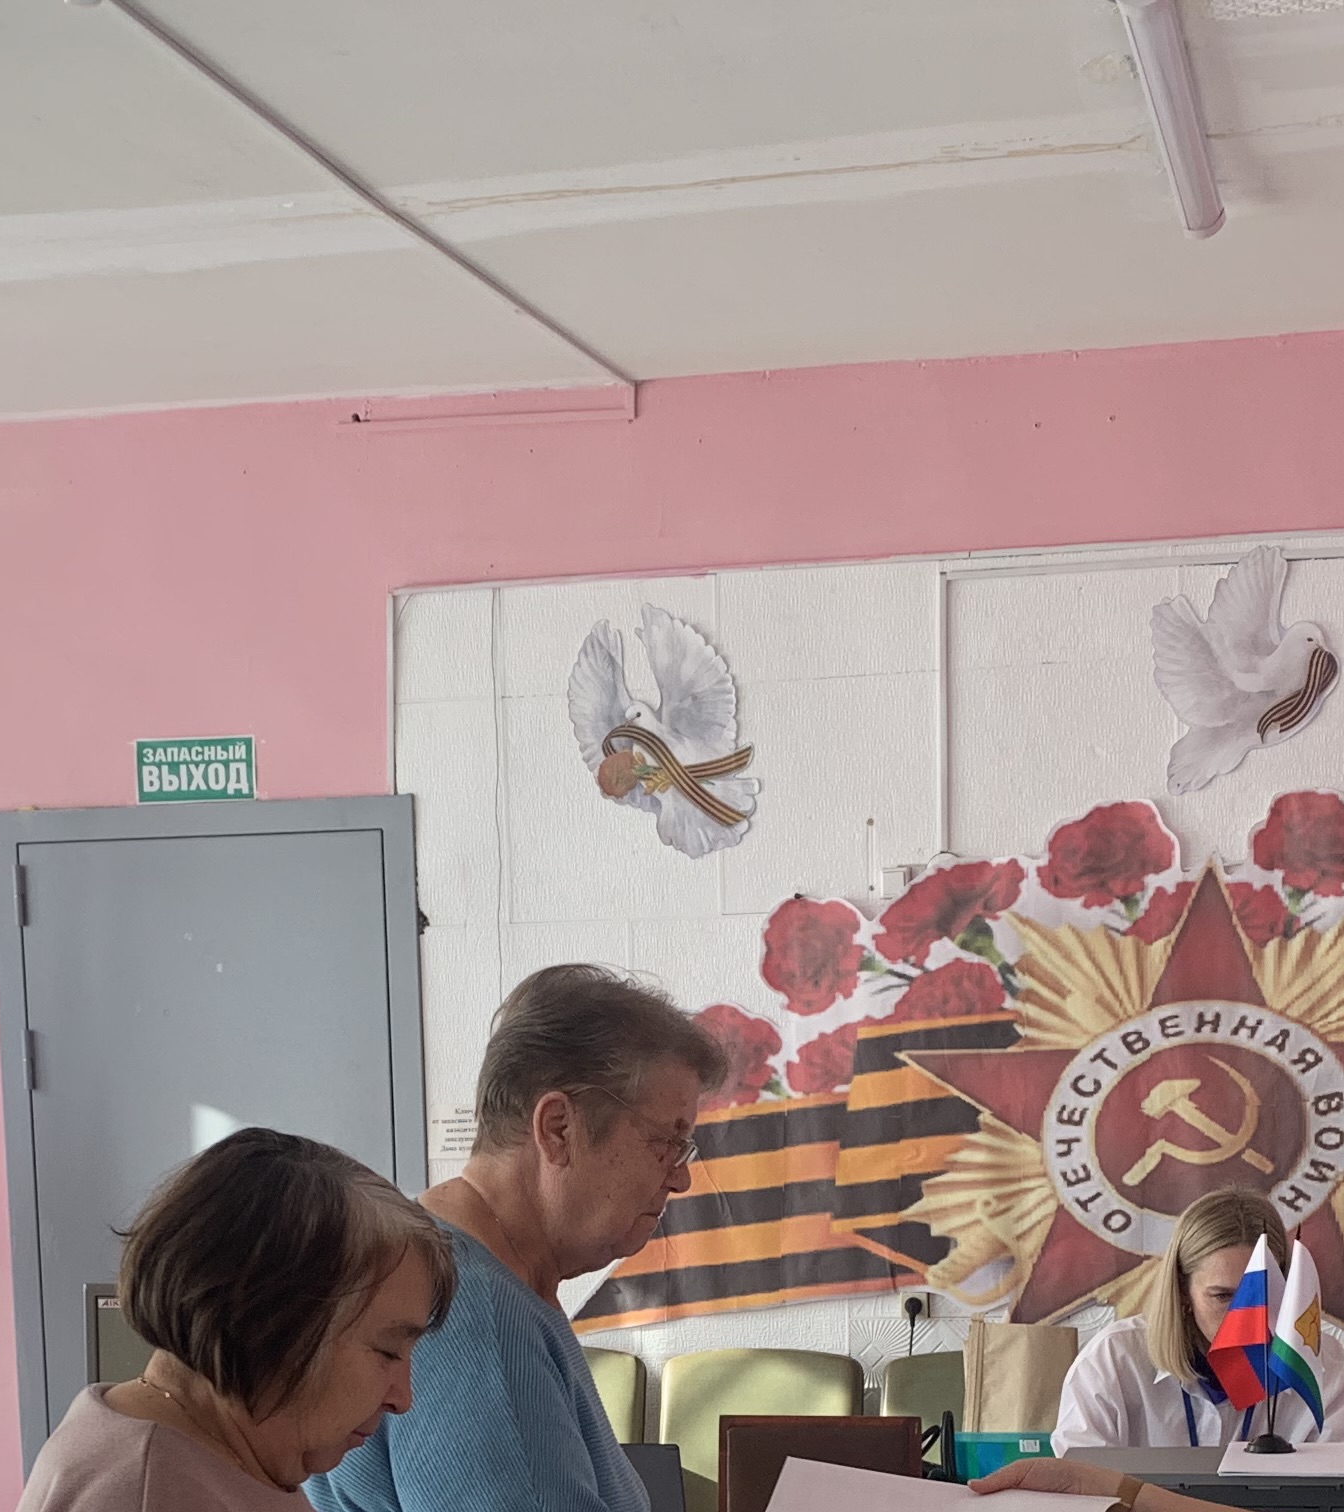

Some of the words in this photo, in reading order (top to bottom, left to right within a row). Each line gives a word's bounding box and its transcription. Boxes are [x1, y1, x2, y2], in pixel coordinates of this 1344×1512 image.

[143, 742, 246, 762] ЗАПАСНЫЙ
[142, 762, 249, 794] ВЫХОД
[1056, 1011, 1324, 1233] ОТЕЧЕСТВЕННАЯ
